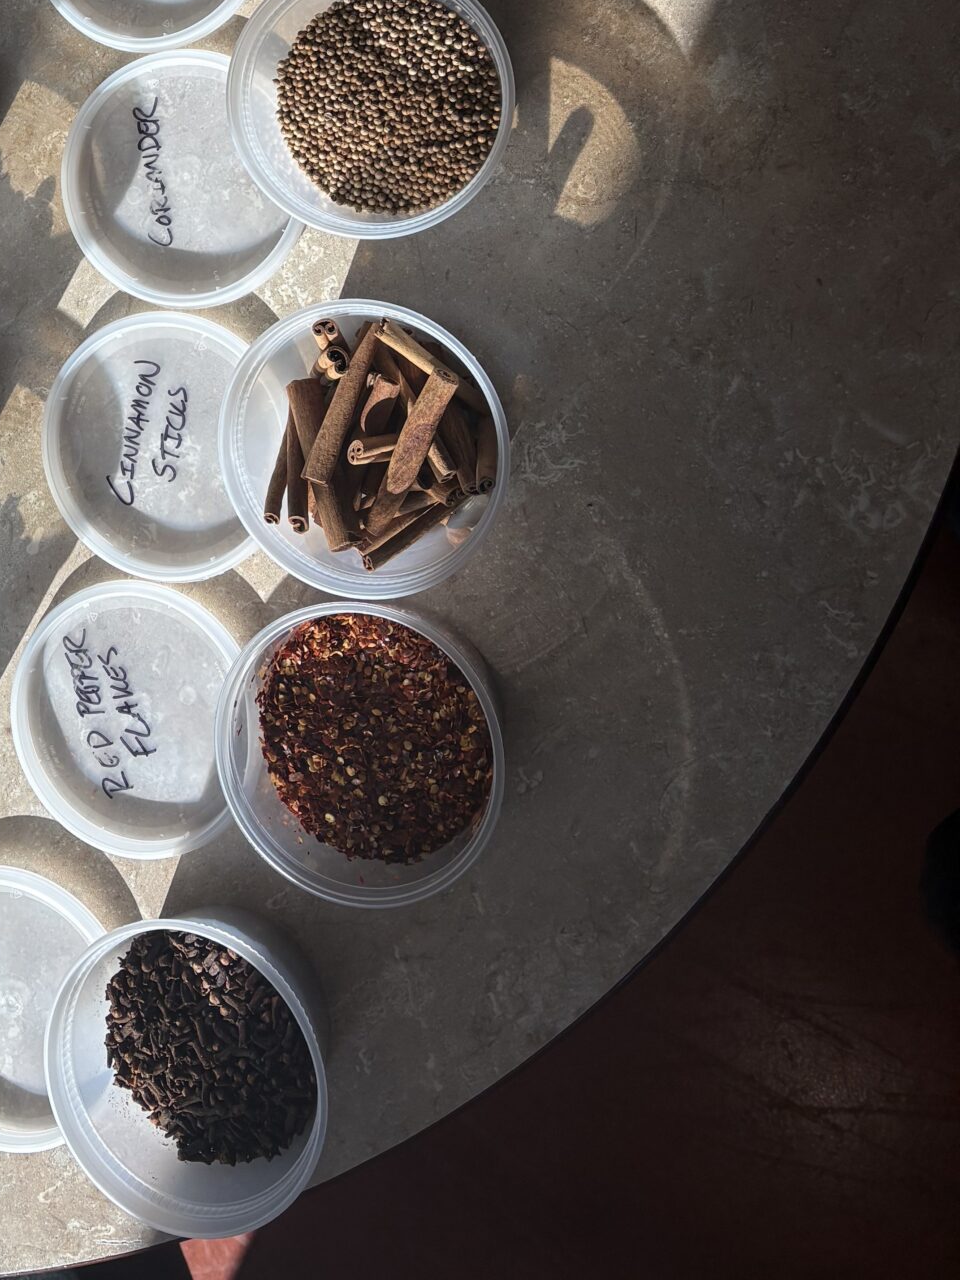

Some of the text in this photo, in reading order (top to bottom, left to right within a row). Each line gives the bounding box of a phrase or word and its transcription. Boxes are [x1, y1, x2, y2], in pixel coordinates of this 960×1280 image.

[132, 96, 174, 247] CORIANDER
[106, 360, 161, 506] CINNAMON
[151, 387, 189, 482] STICKS
[97, 646, 157, 758] FLAKES
[87, 730, 134, 800] RED
